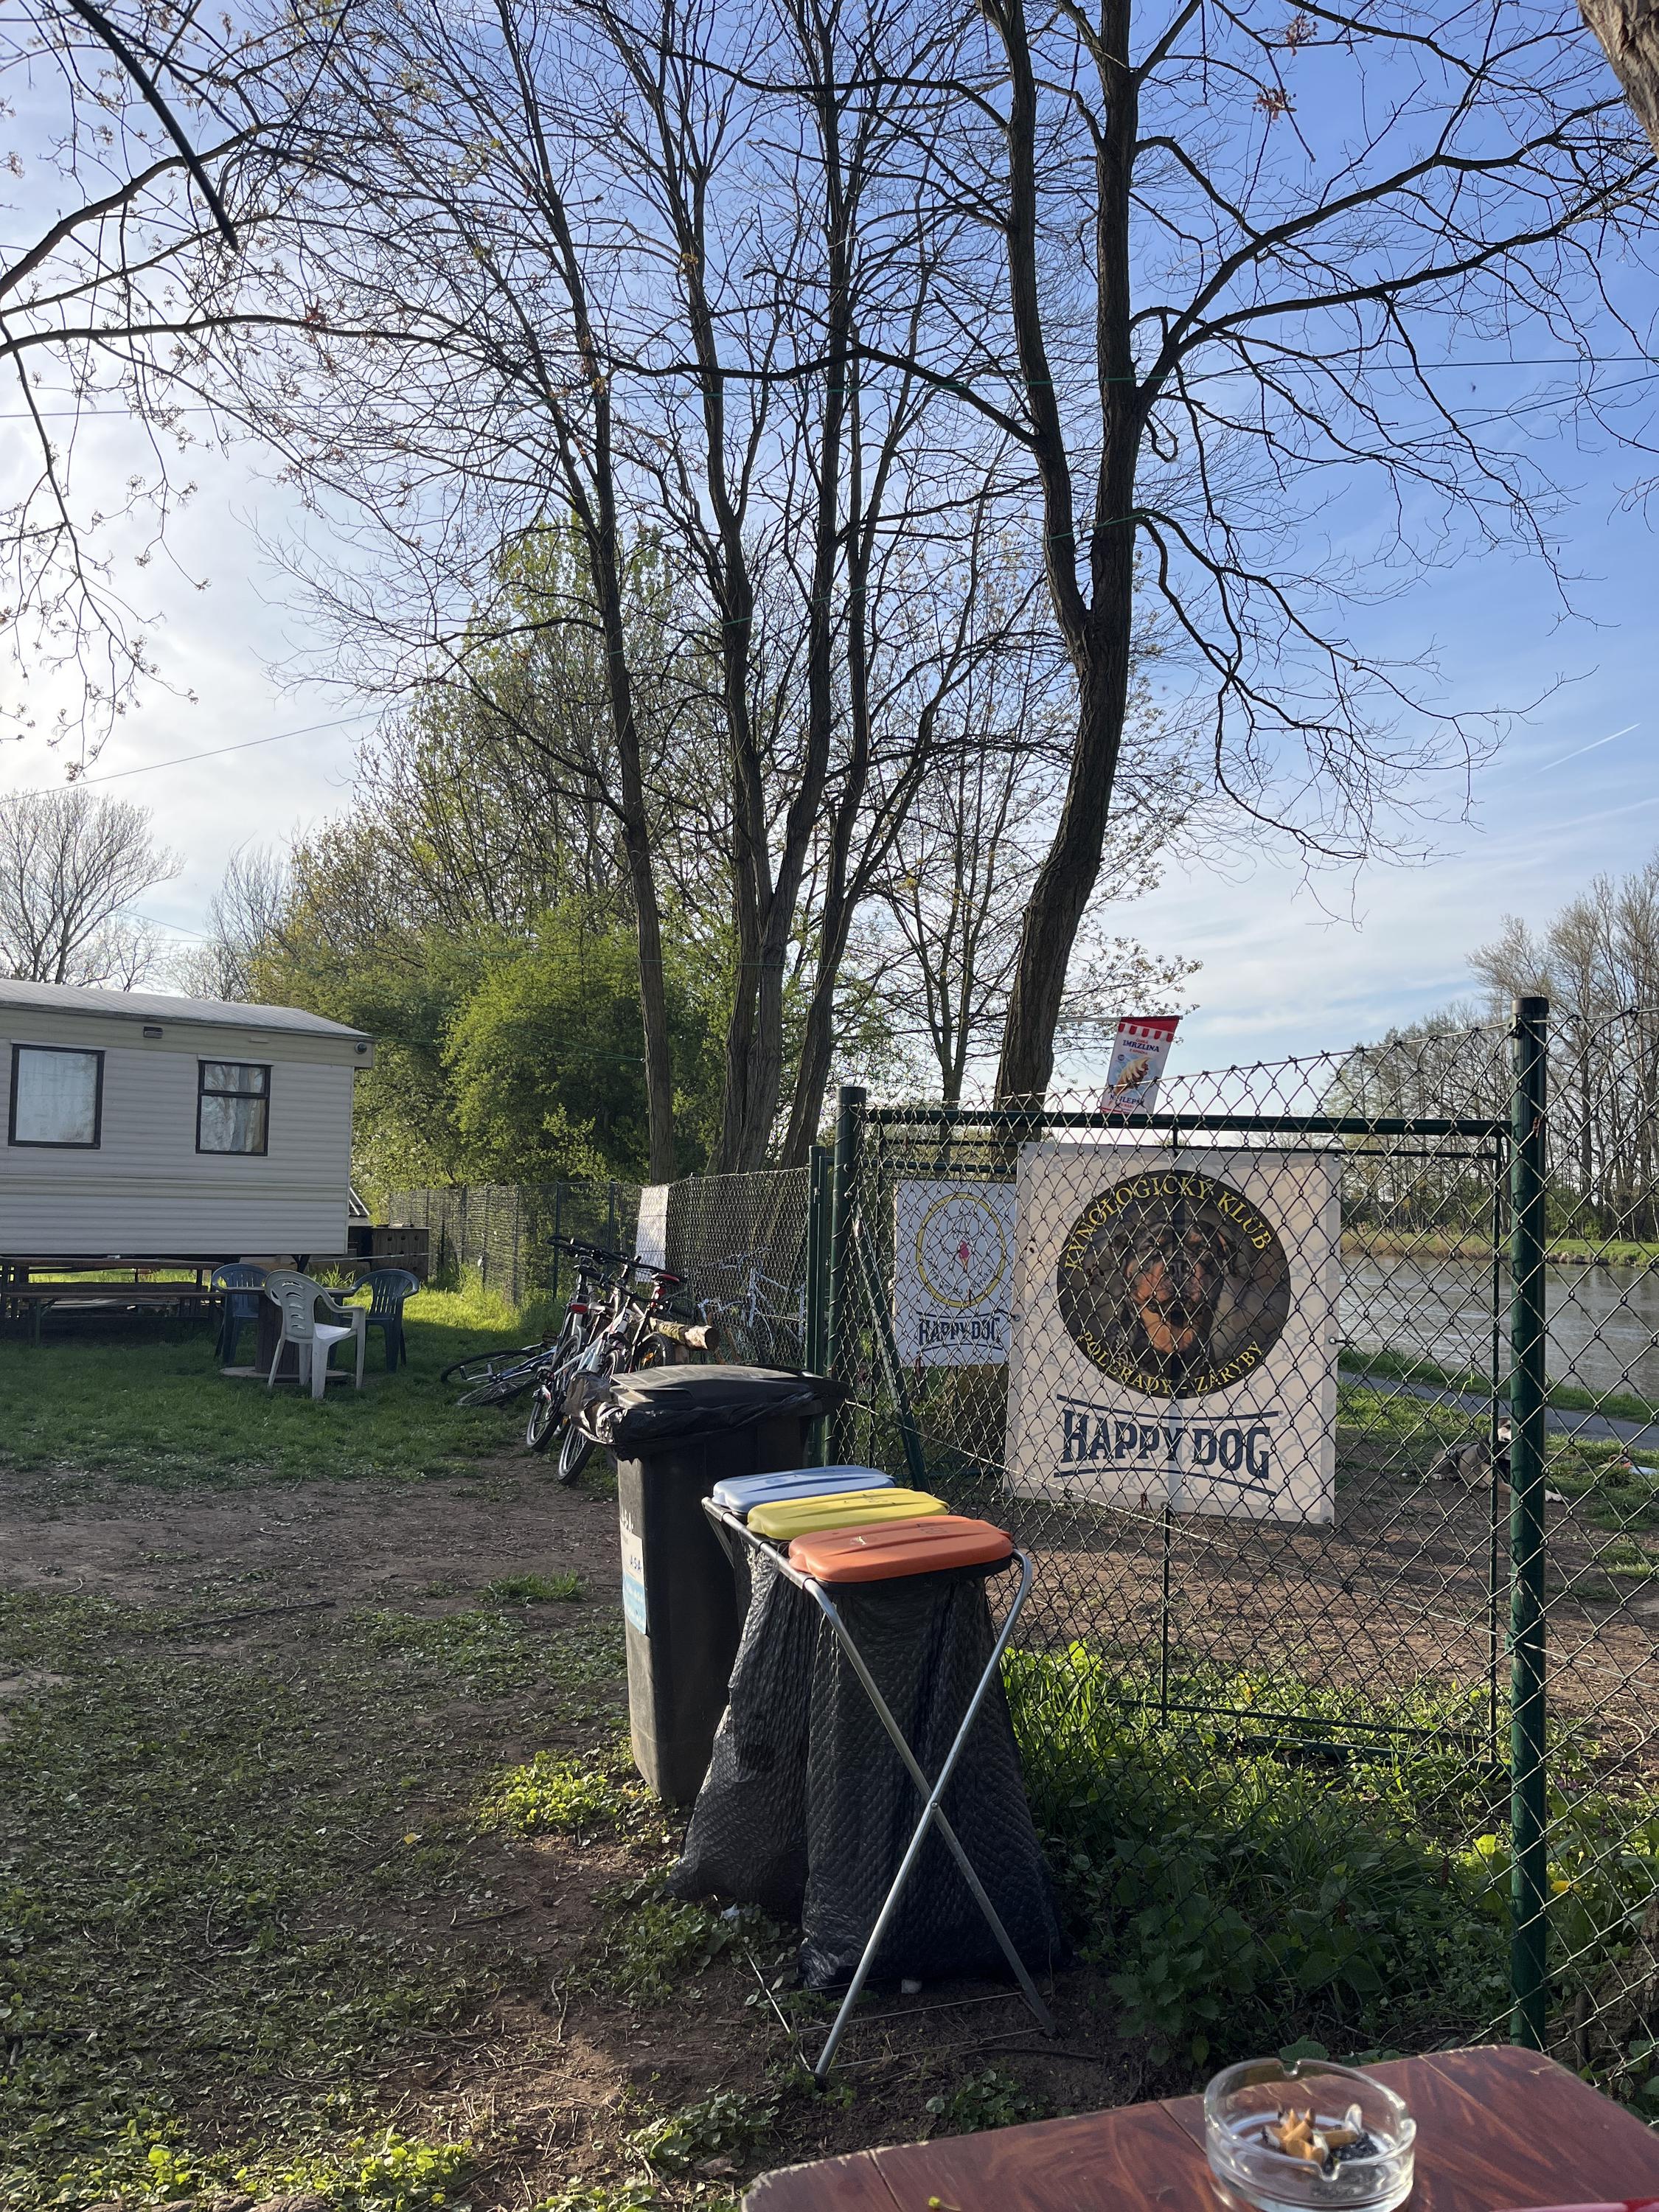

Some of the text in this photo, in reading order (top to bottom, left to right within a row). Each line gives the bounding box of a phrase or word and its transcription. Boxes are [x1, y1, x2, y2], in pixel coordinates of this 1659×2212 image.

[1122, 1040, 1159, 1052] ZMRZLINA
[1064, 1176, 1272, 1272] KYNOLOGICKÝ KLUB
[919, 1318, 968, 1346] HAPPY
[1060, 1409, 1271, 1480] HAPPY DOG
